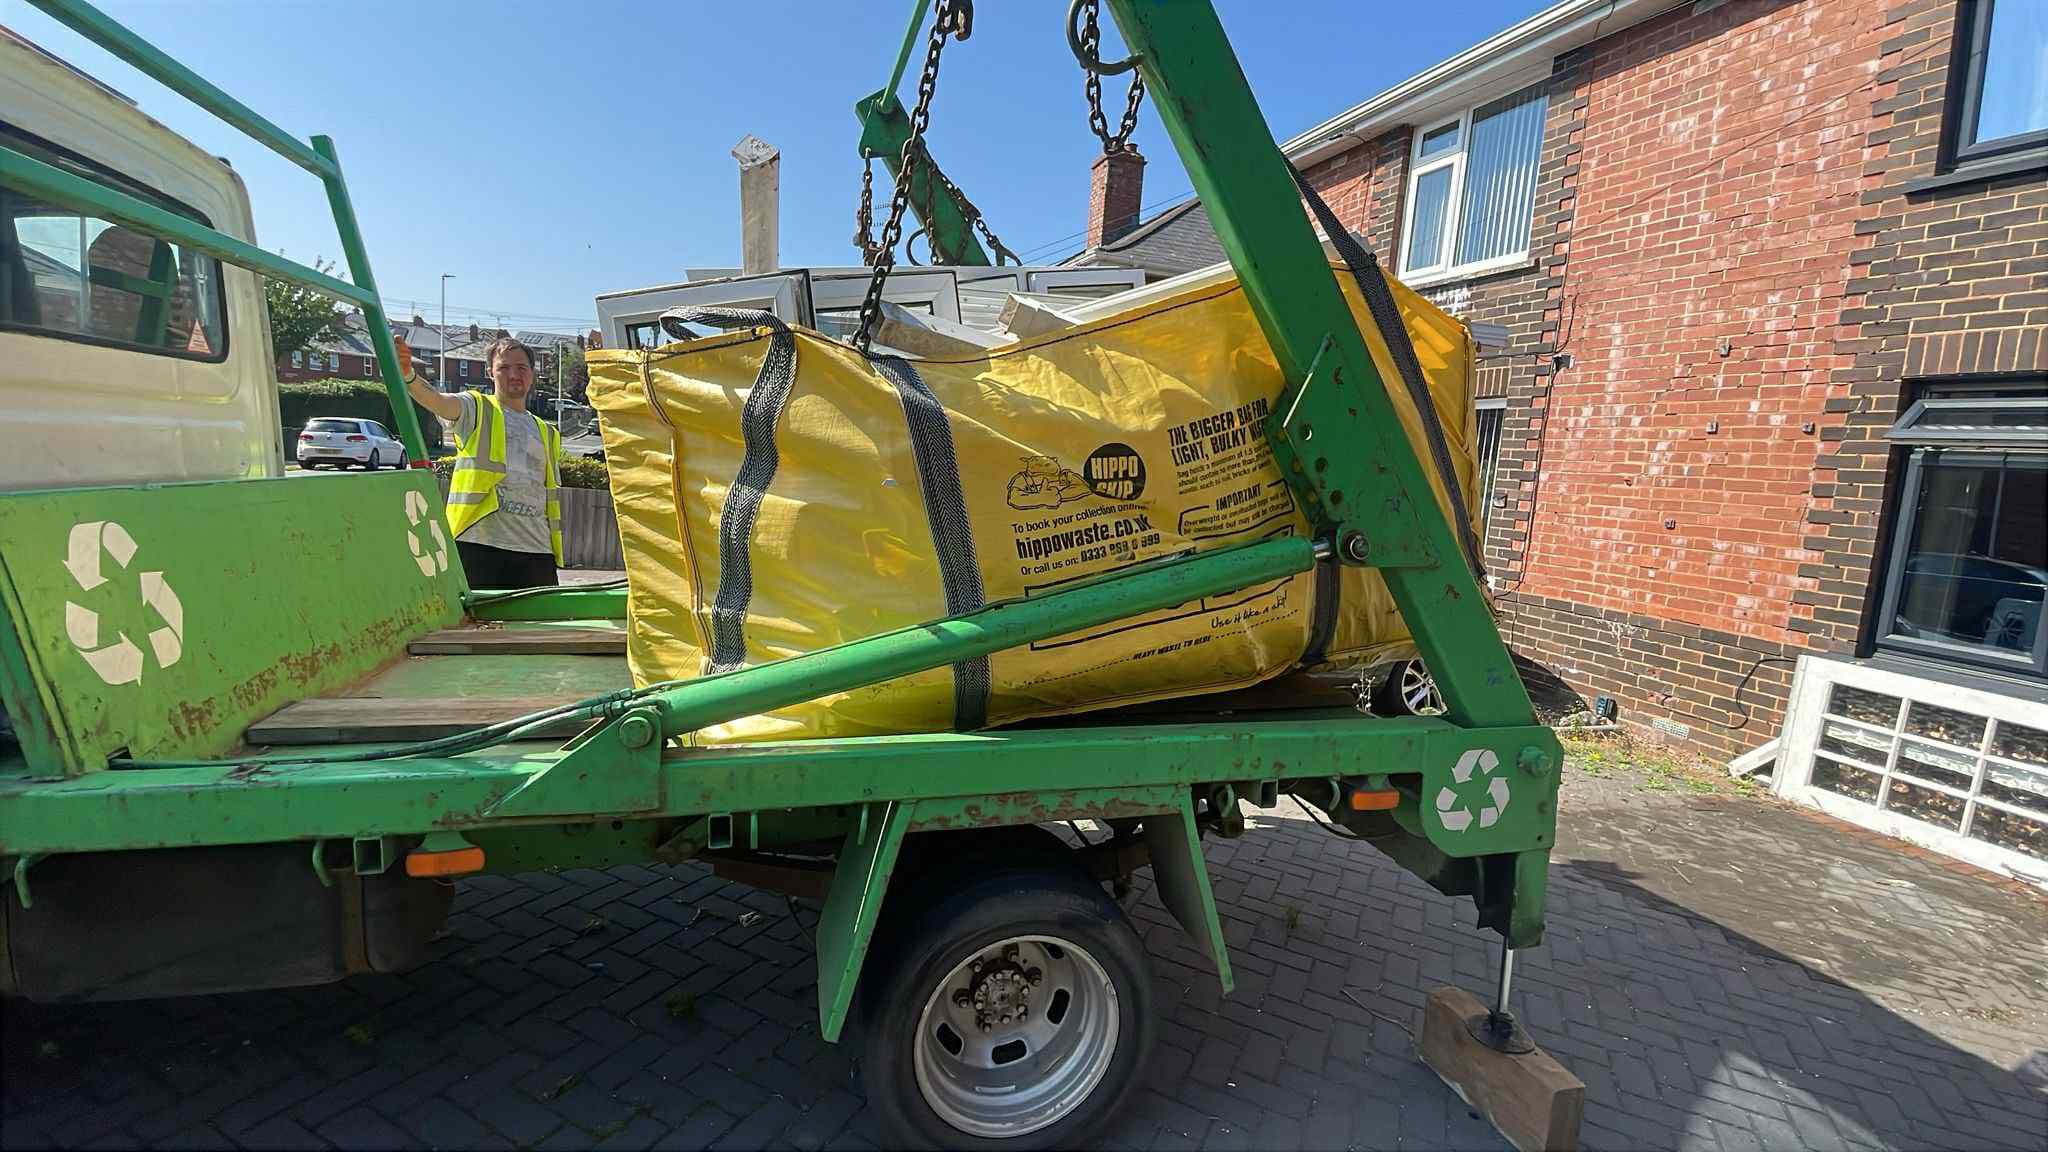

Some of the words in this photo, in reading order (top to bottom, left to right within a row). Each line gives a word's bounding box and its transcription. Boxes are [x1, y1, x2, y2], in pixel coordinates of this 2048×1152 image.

[1167, 425, 1189, 447] THE
[1189, 411, 1235, 440] BIGGER
[1251, 398, 1269, 419] FOR
[1171, 441, 1210, 467] LIGHT,
[1210, 427, 1247, 455] BULKY
[1090, 455, 1139, 480] HIPPO
[1215, 483, 1261, 511] IMPORTANT
[1012, 523, 1024, 533] To
[1026, 519, 1051, 532] book
[1053, 514, 1074, 529] your
[1075, 504, 1116, 522] collection
[1015, 513, 1152, 560] hippowaste.co.uk
[1020, 566, 1031, 576] Or
[1033, 562, 1051, 575] call
[1051, 560, 1064, 570] us
[1065, 557, 1079, 567] on:
[1080, 546, 1107, 563] 0333
[1211, 616, 1233, 629] Use
